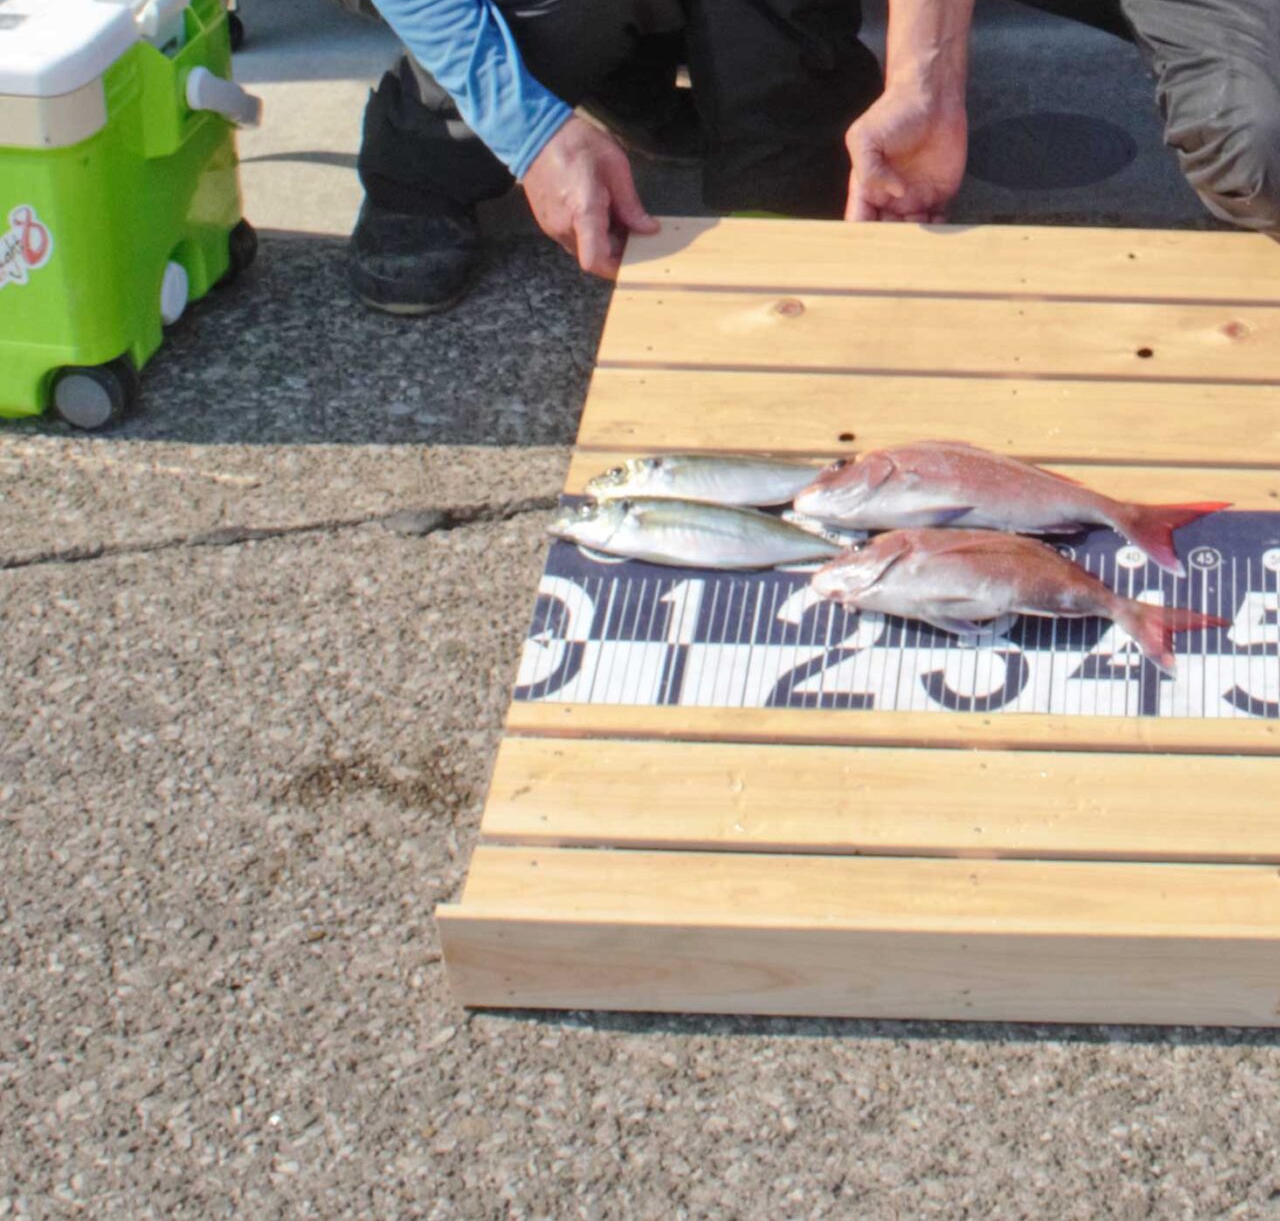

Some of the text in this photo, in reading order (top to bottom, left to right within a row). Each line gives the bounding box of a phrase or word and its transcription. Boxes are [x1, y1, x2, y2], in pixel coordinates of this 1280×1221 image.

[1196, 552, 1214, 565] 45
[656, 578, 705, 705] 1
[765, 583, 886, 710] 2
